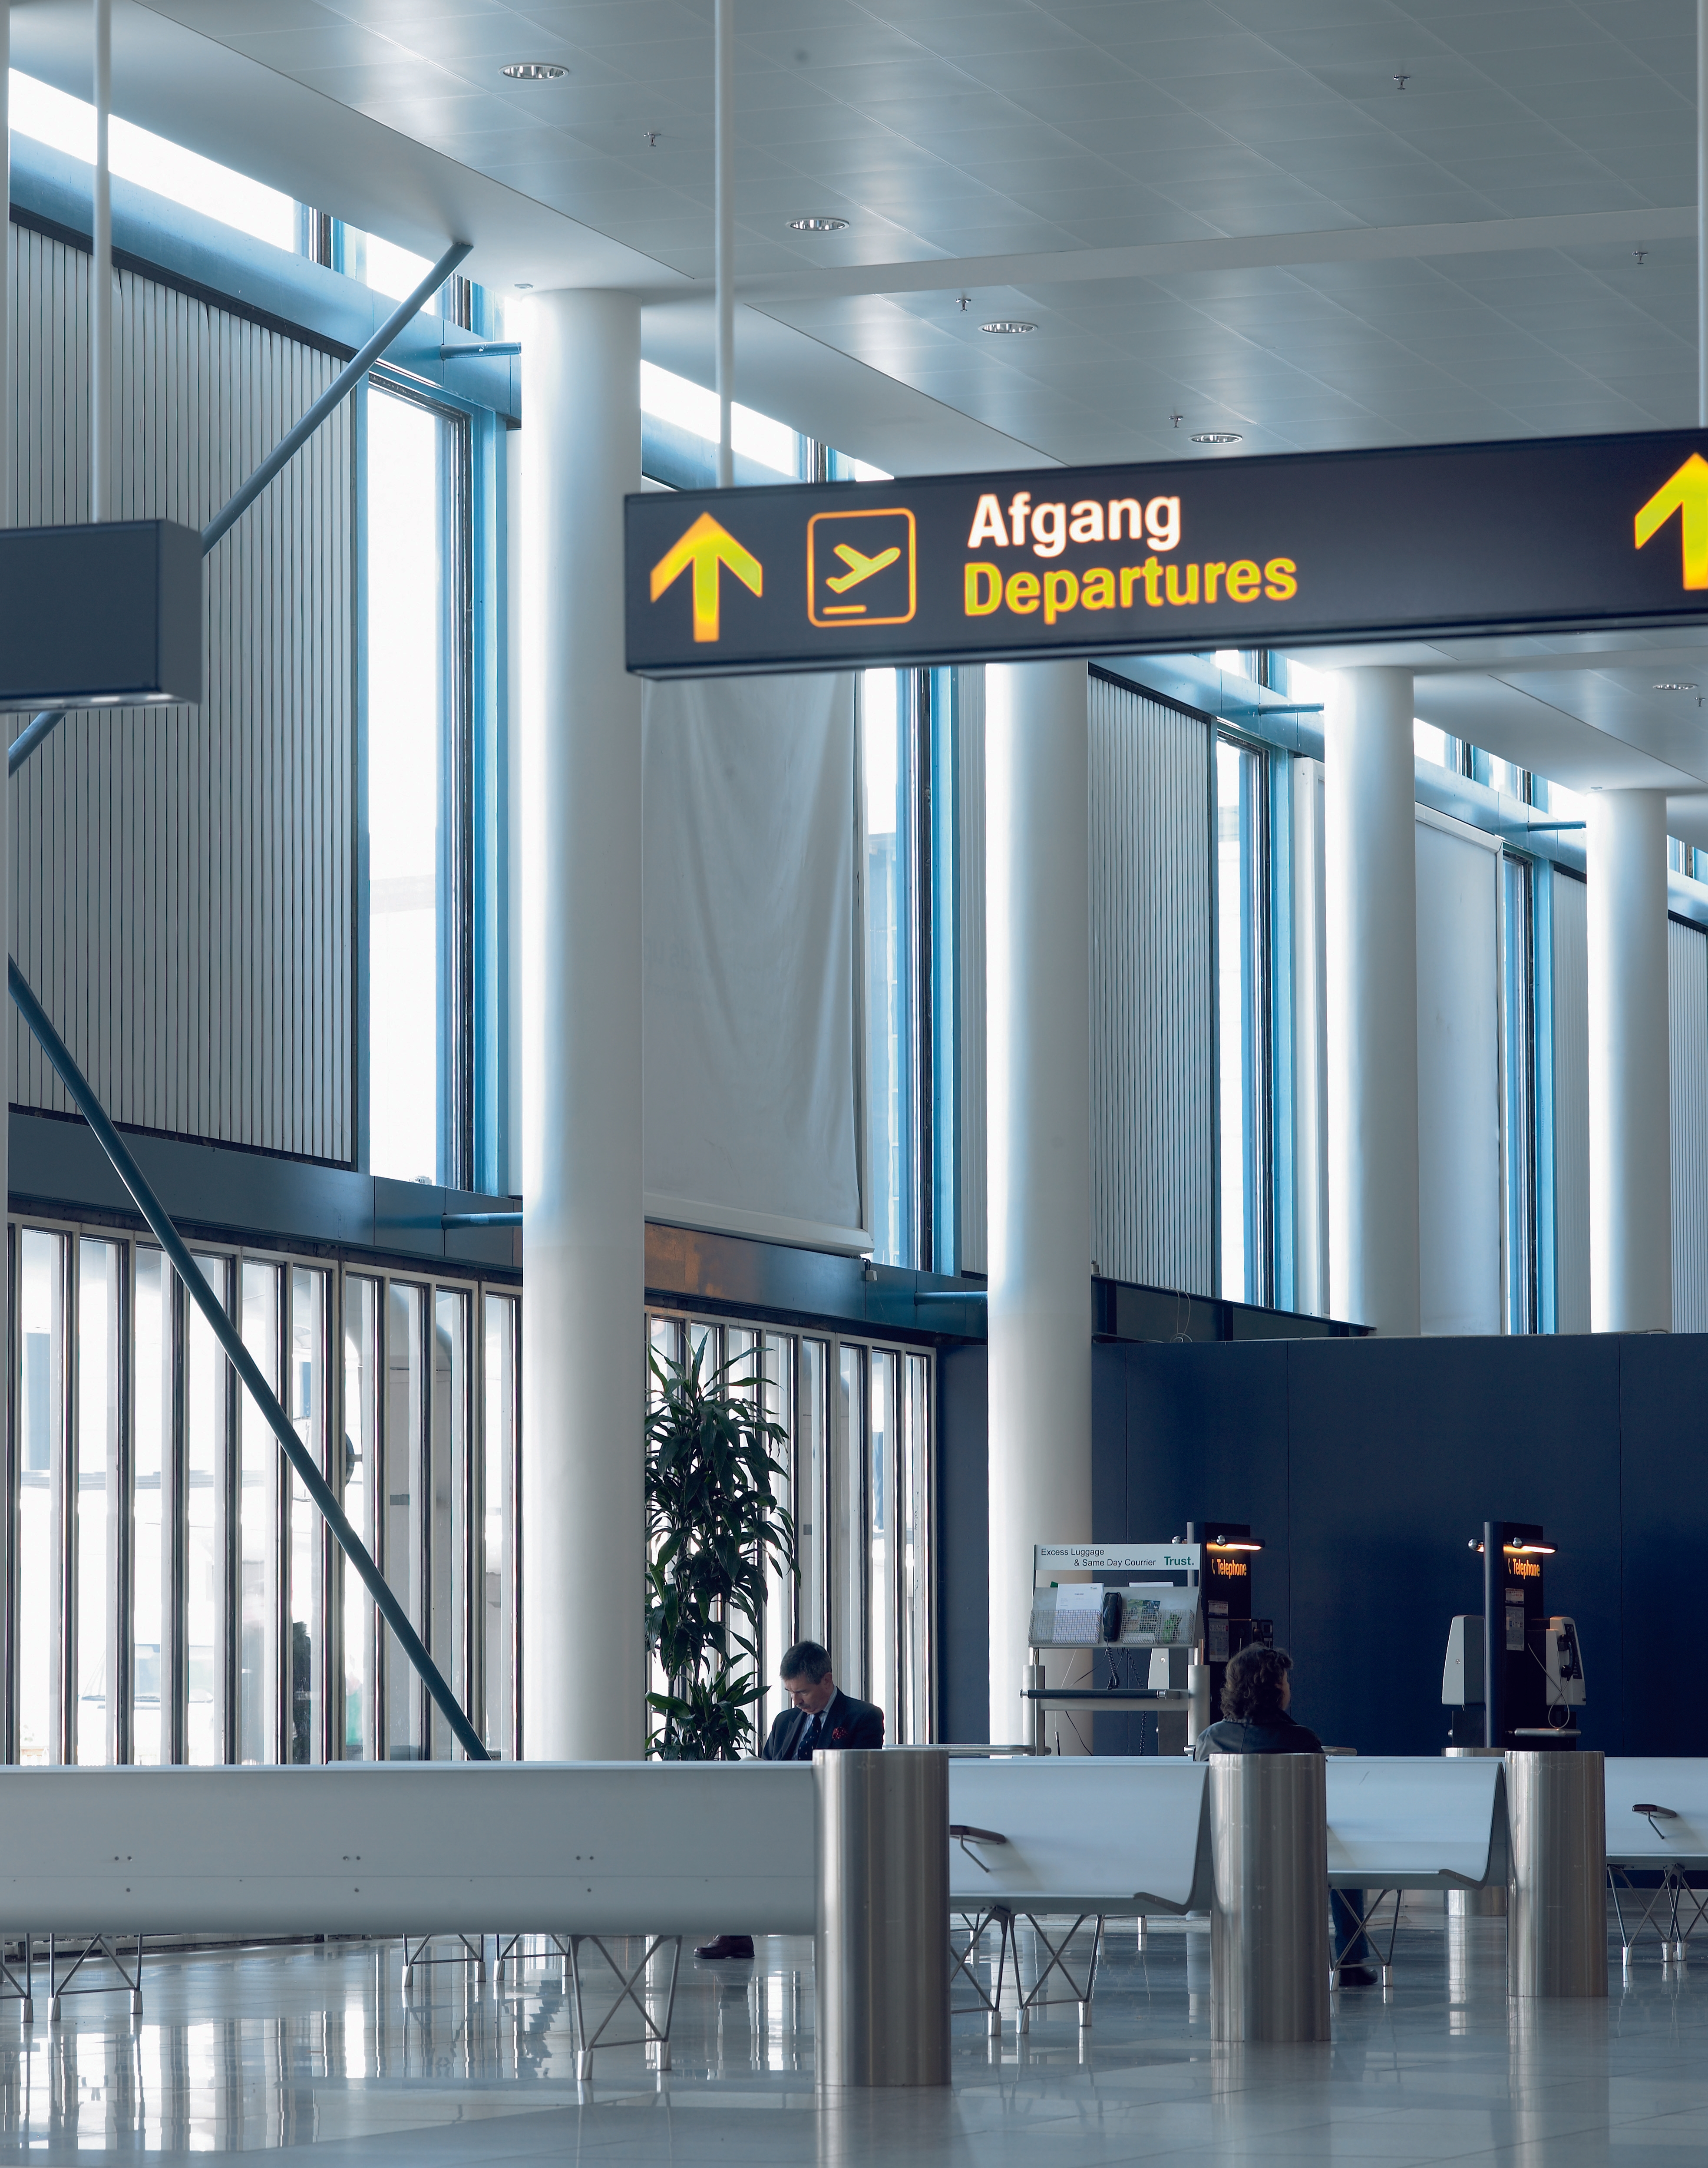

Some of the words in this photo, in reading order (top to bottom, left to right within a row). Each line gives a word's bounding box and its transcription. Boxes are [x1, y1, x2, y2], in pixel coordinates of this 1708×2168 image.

[967, 492, 1181, 558] Afgang
[964, 556, 1298, 625] Departures
[1071, 1548, 1104, 1557] Luggage
[1107, 1559, 1122, 1568] Day
[1125, 1558, 1156, 1567] Courrier
[1216, 1558, 1247, 1580] Telephone
[1512, 1557, 1540, 1580] Telephone
